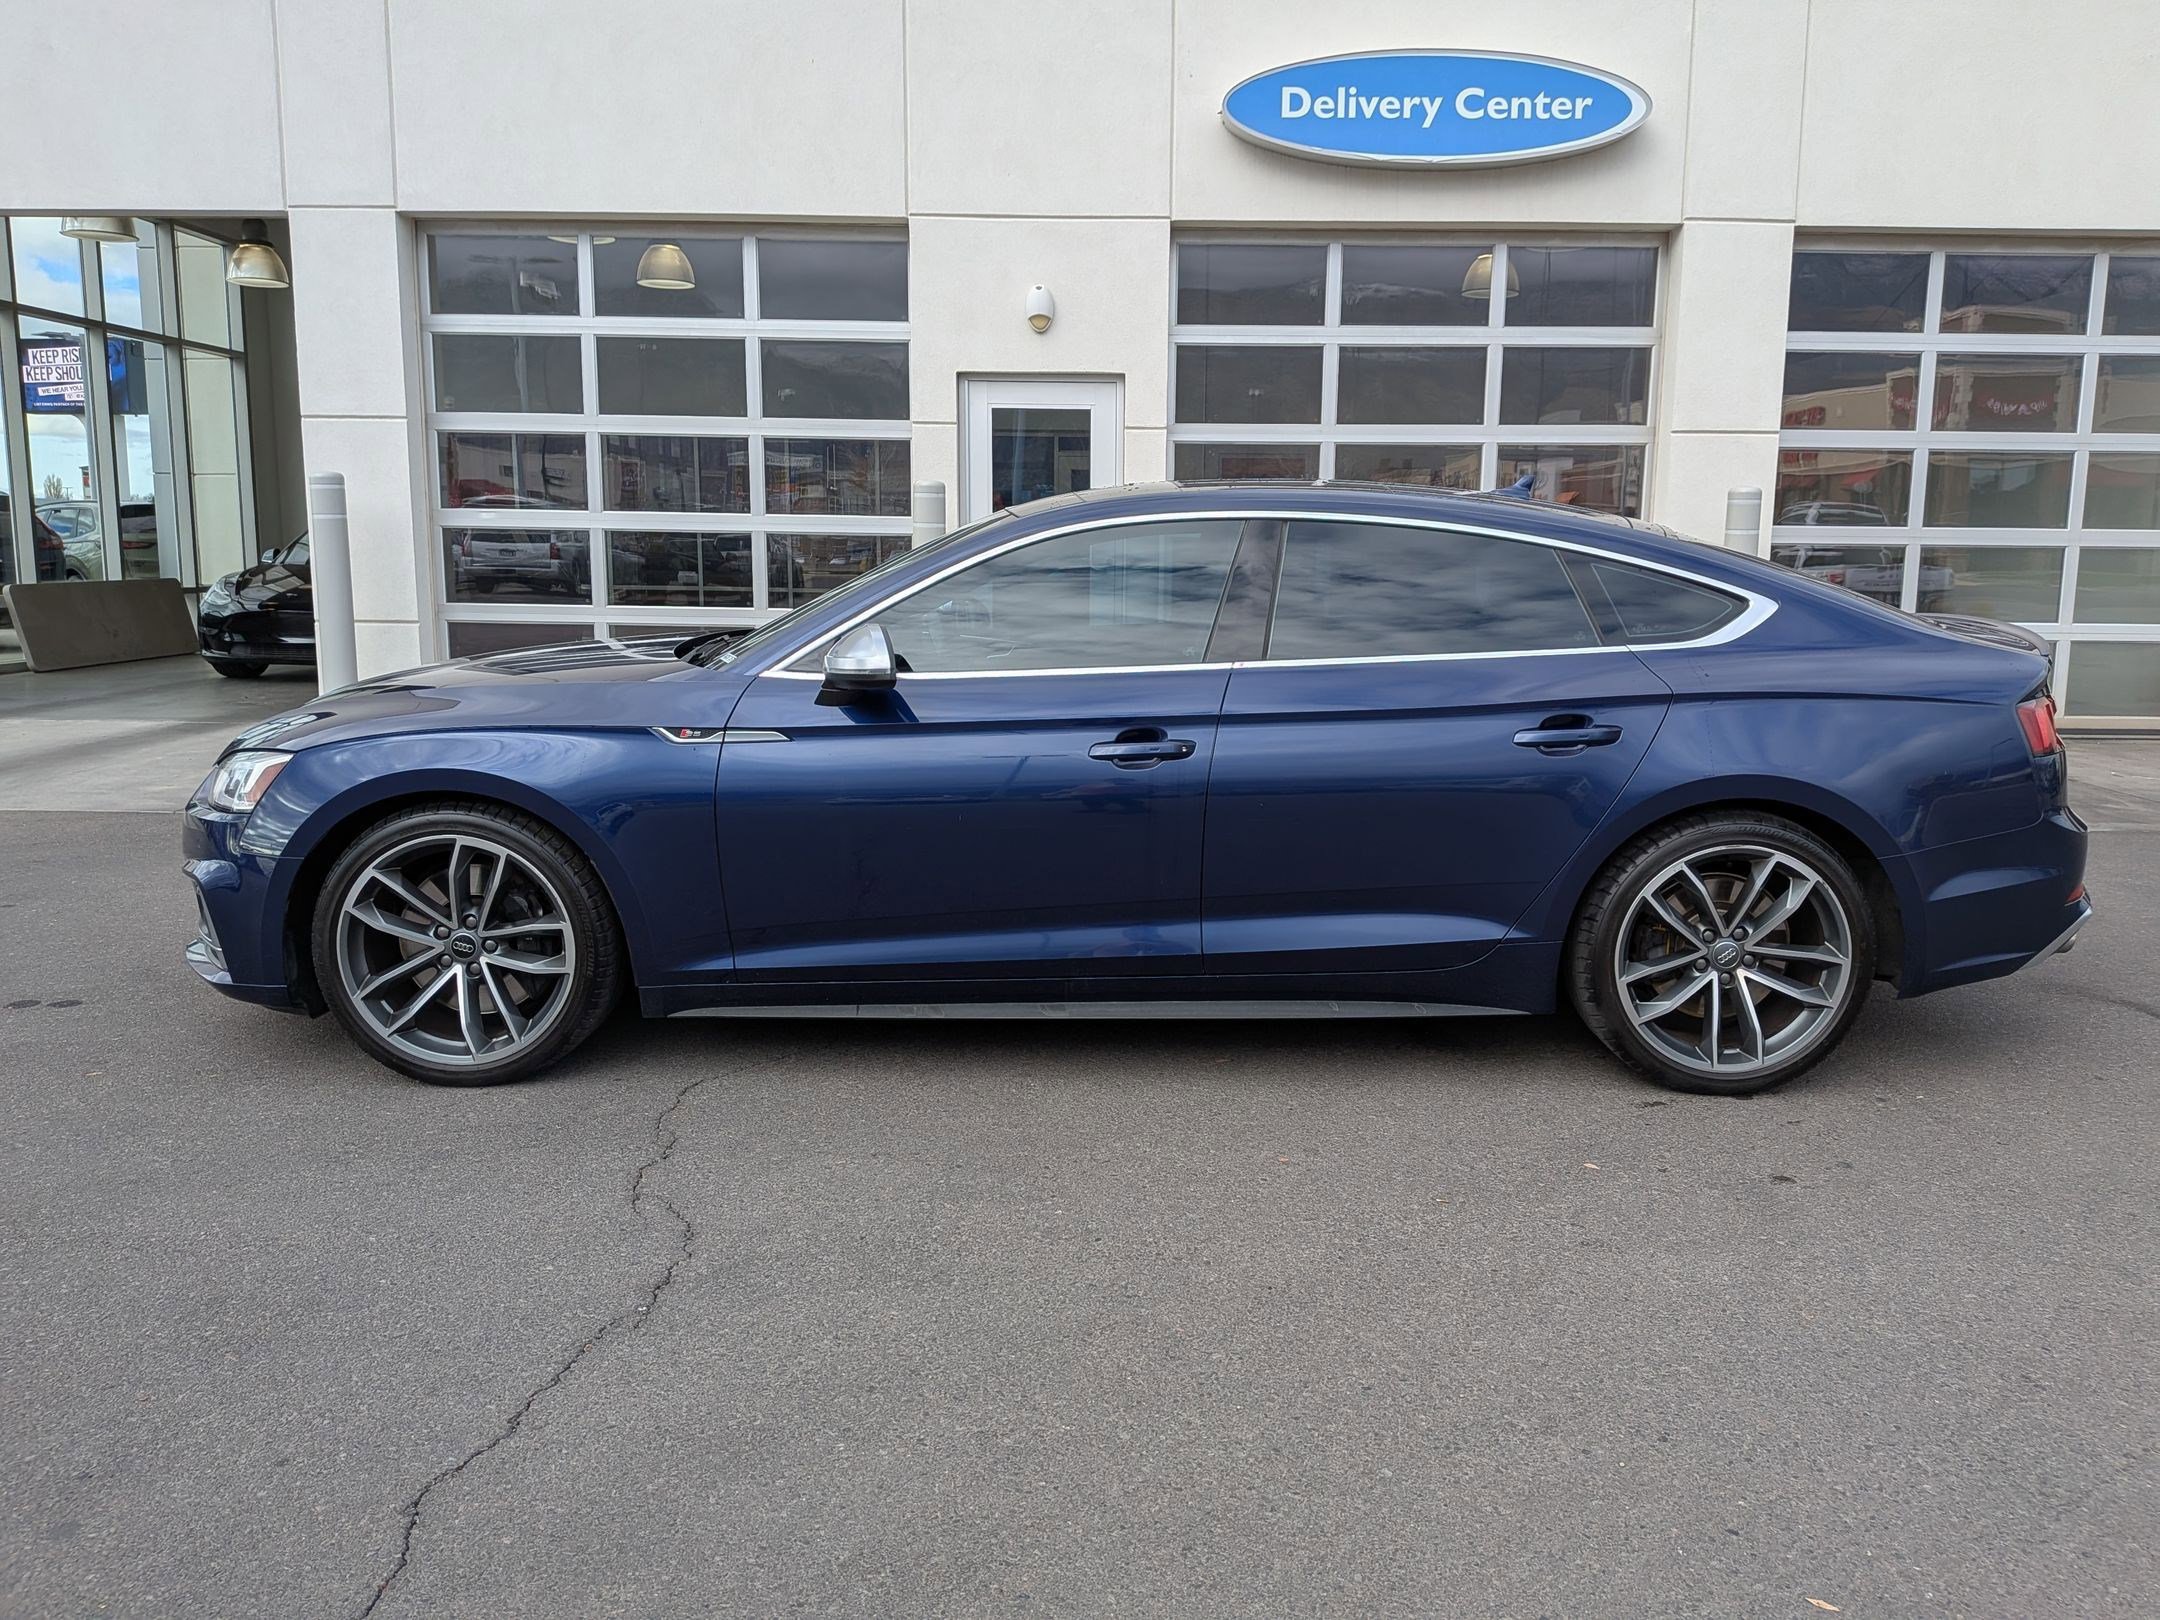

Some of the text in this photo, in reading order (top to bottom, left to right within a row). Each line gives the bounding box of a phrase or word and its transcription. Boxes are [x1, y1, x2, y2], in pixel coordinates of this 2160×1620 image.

[1280, 86, 1594, 128] Delivery Center
[31, 349, 59, 364] KEEP
[25, 366, 53, 381] KEEP
